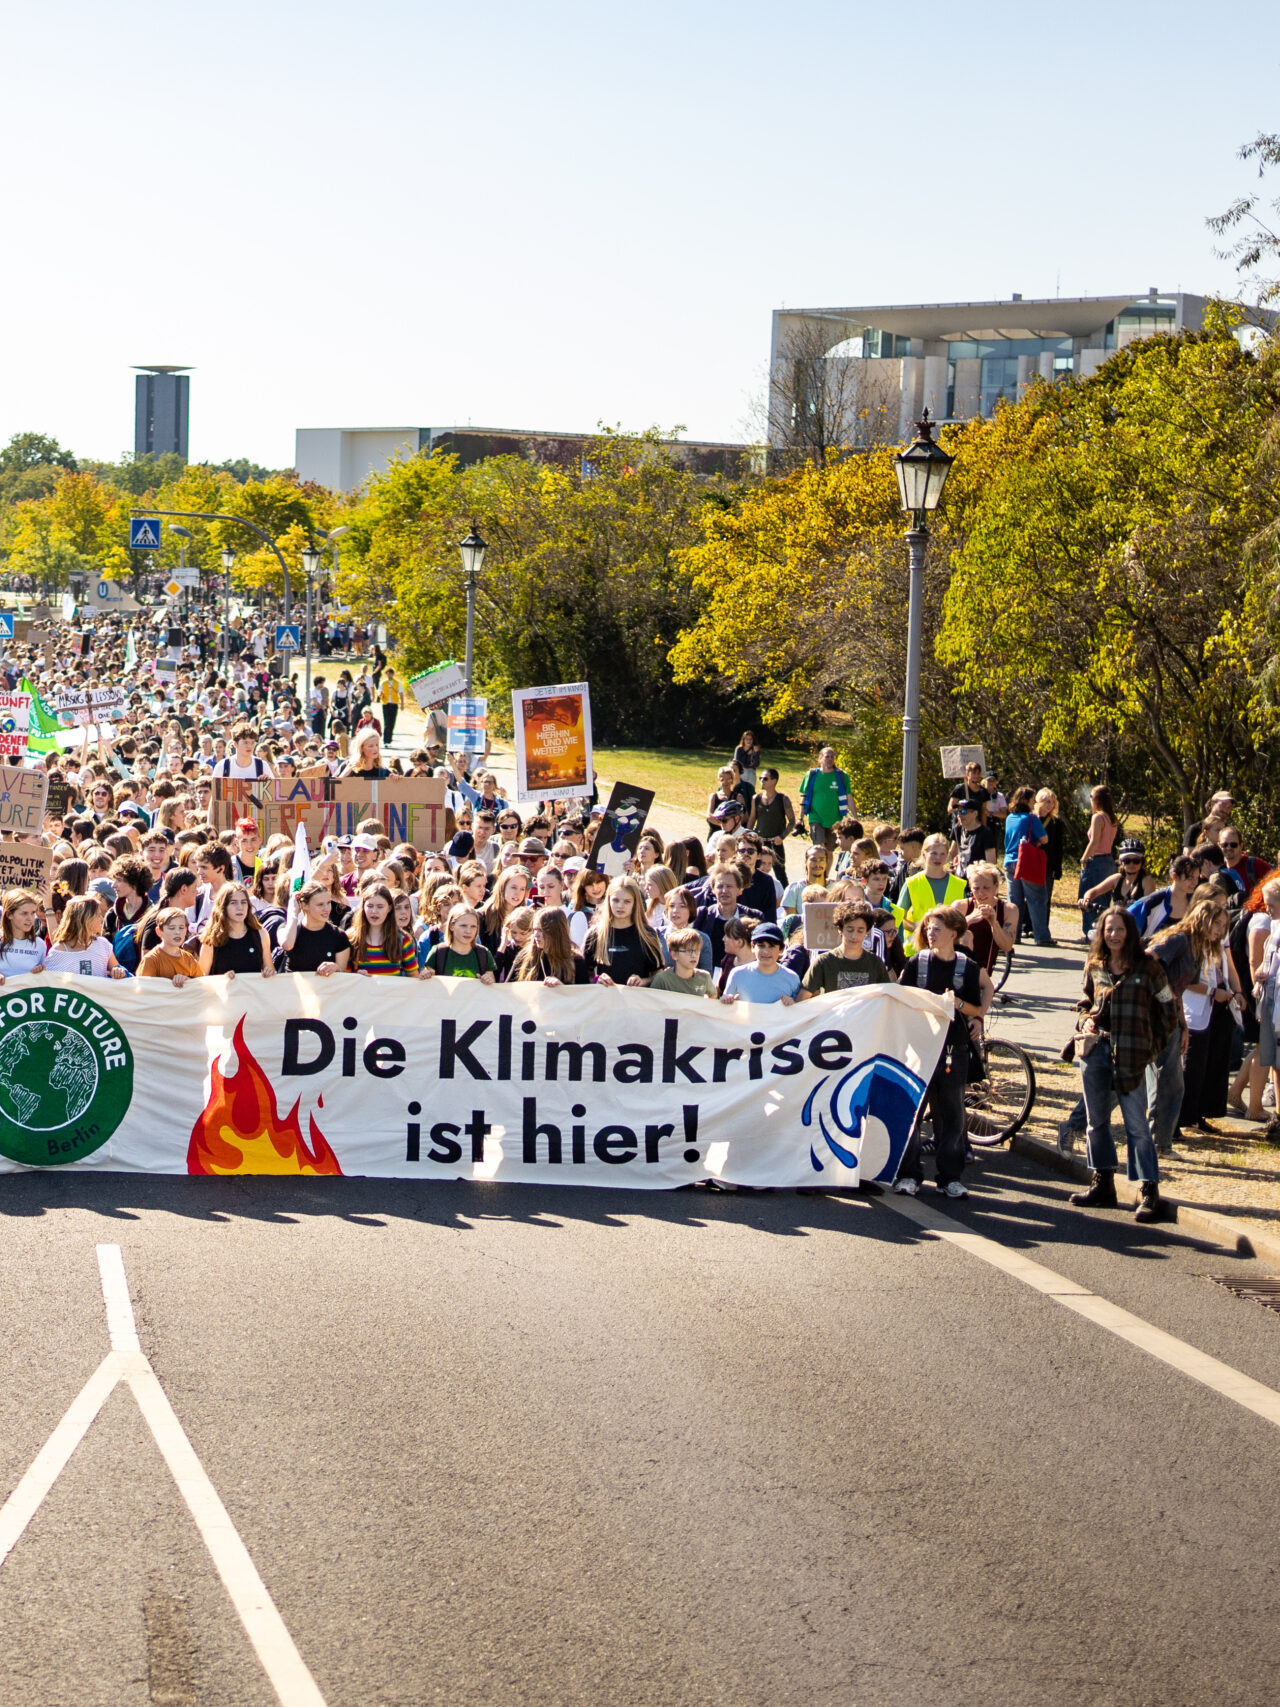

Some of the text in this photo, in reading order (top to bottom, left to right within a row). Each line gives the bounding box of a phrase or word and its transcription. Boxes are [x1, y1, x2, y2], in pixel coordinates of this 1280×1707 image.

[536, 729, 570, 740] HIERHIN
[542, 723, 556, 732] BIS
[543, 736, 578, 747] UND WIE
[532, 745, 568, 756] WEITER?
[215, 778, 253, 801] IHR
[20, 867, 40, 878] UNS
[53, 993, 126, 1071] FUTURE
[281, 1016, 407, 1079] Die
[439, 1014, 854, 1084] Klimakrise
[405, 1101, 492, 1164] ist
[522, 1096, 701, 1165] hier!
[47, 1122, 101, 1157] Berlin
